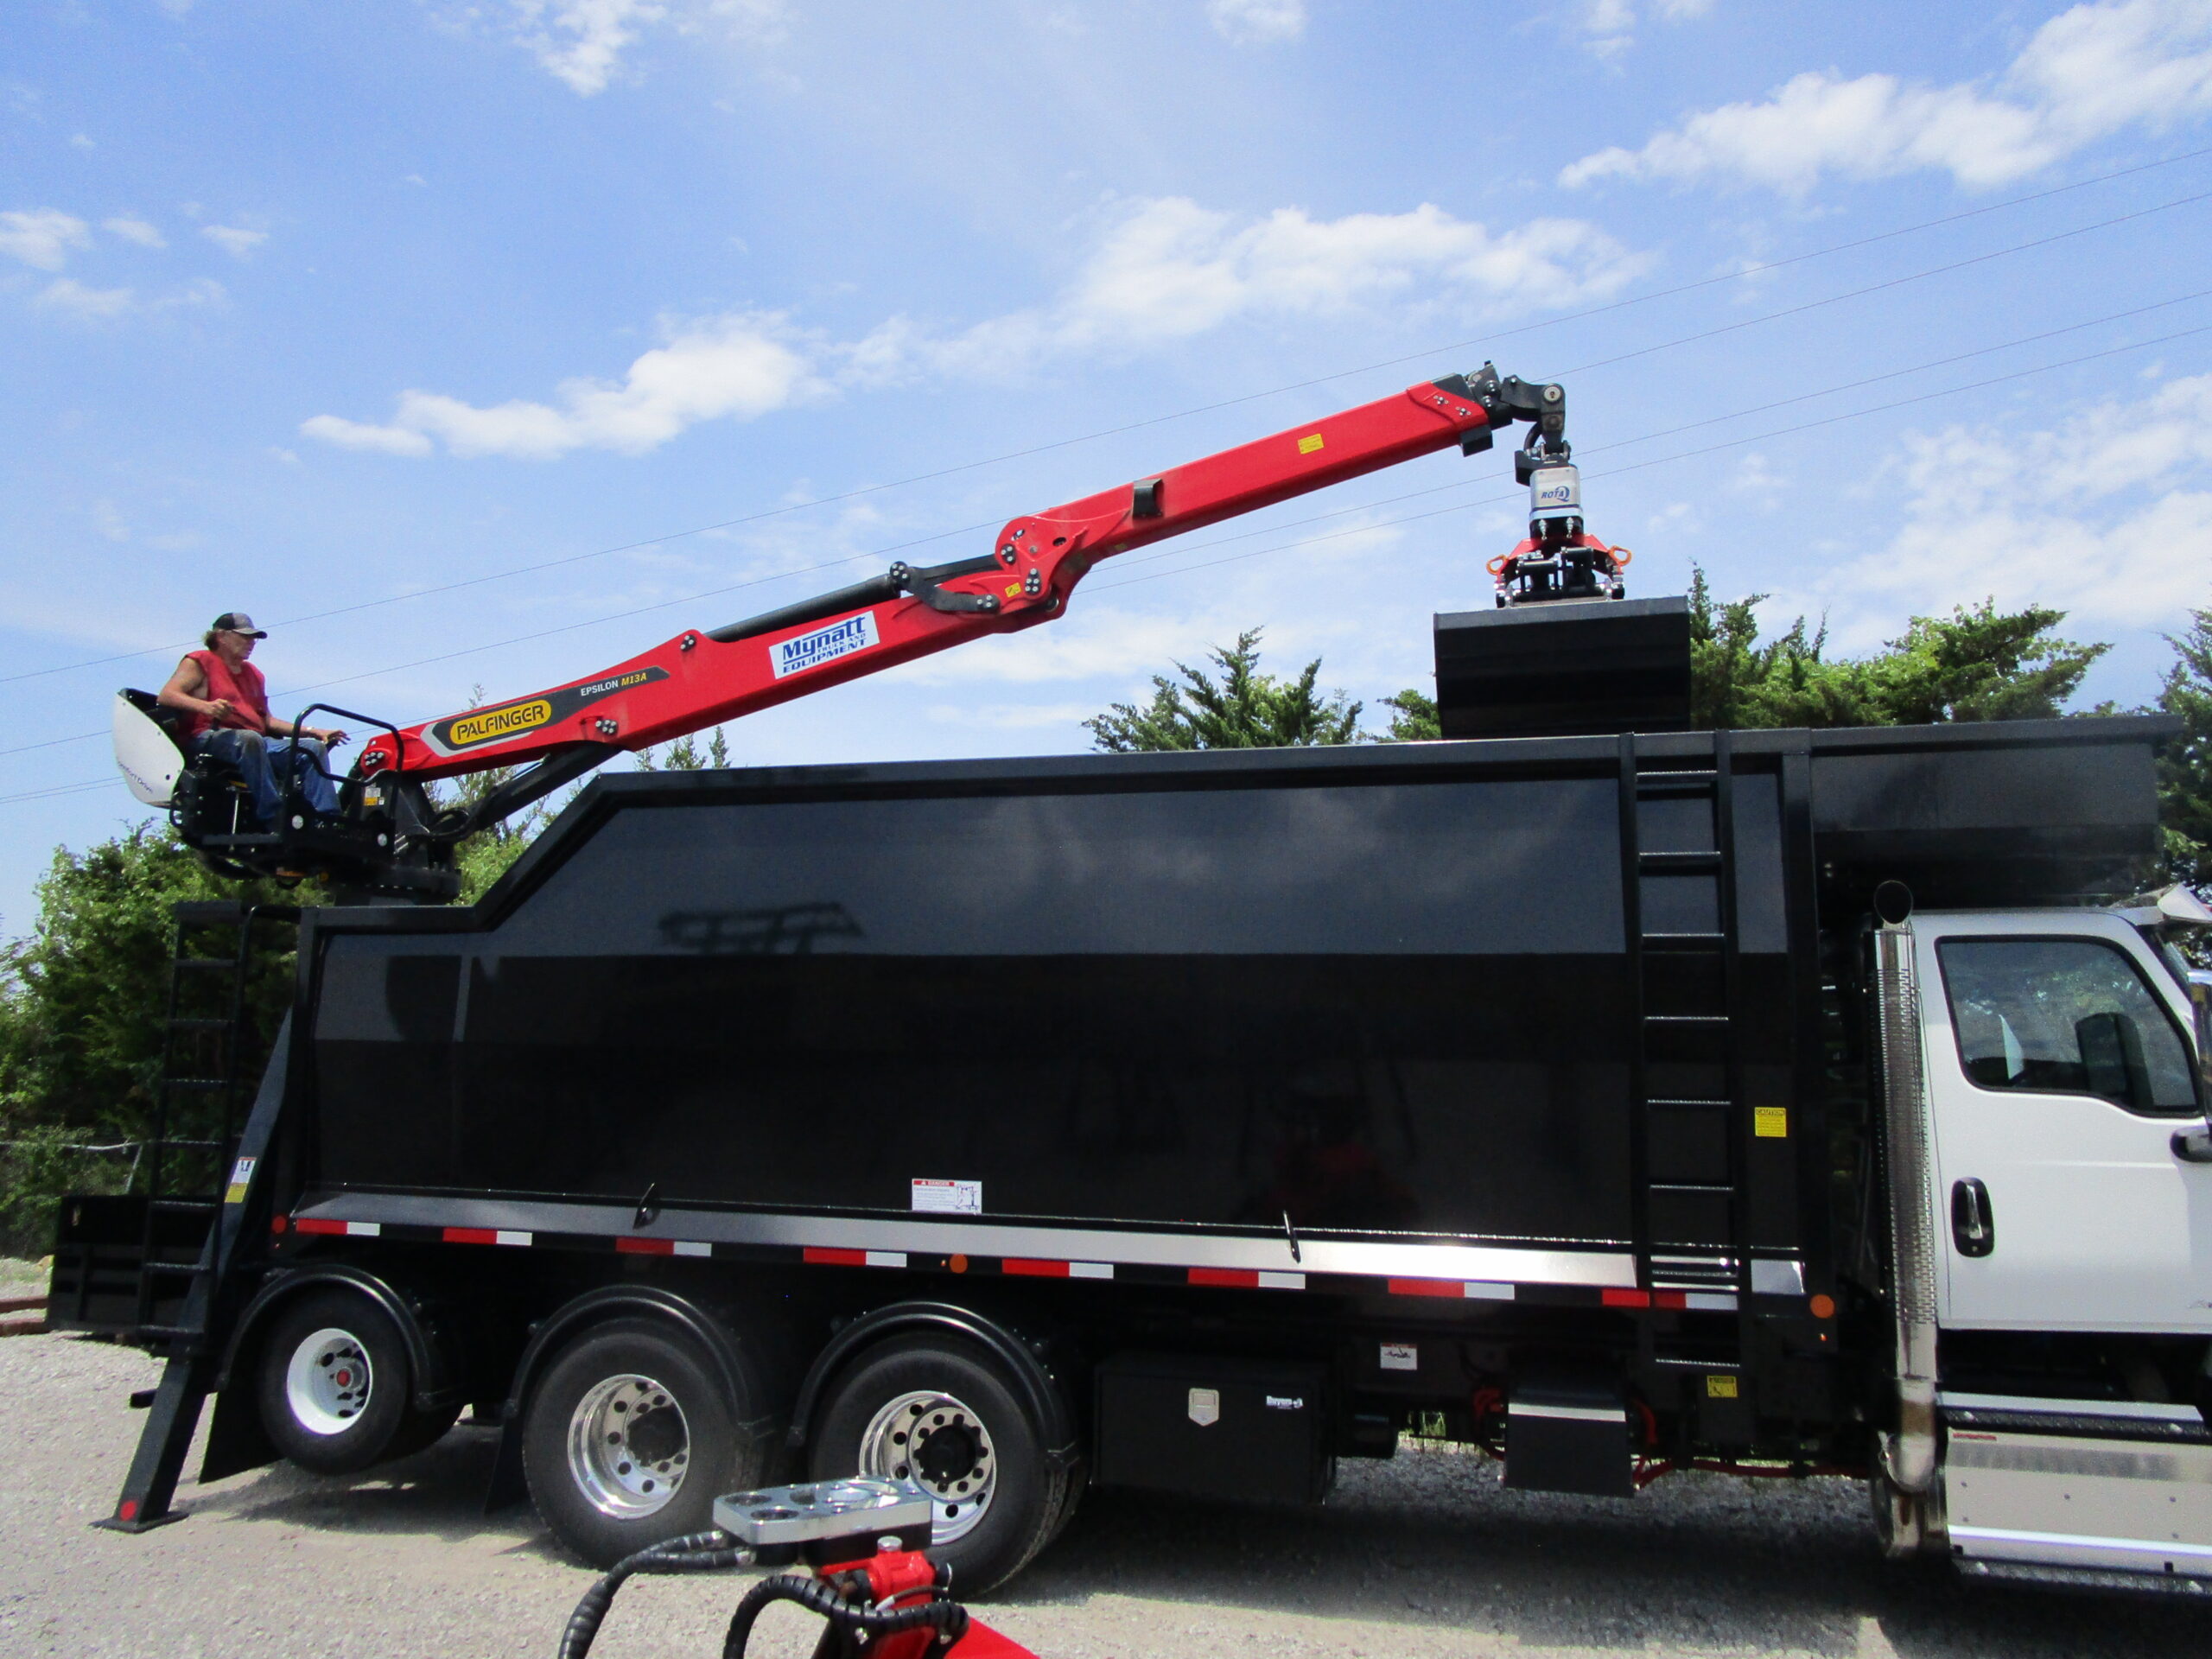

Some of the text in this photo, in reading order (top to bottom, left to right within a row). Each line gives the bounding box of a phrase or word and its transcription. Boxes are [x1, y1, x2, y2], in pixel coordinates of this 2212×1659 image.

[783, 616, 866, 661] Mynatt
[817, 632, 867, 653] TRUCK AND
[783, 639, 867, 674] EQUIPMENT
[580, 672, 648, 696] EPSILON M13A
[456, 704, 545, 741] PALFINGER
